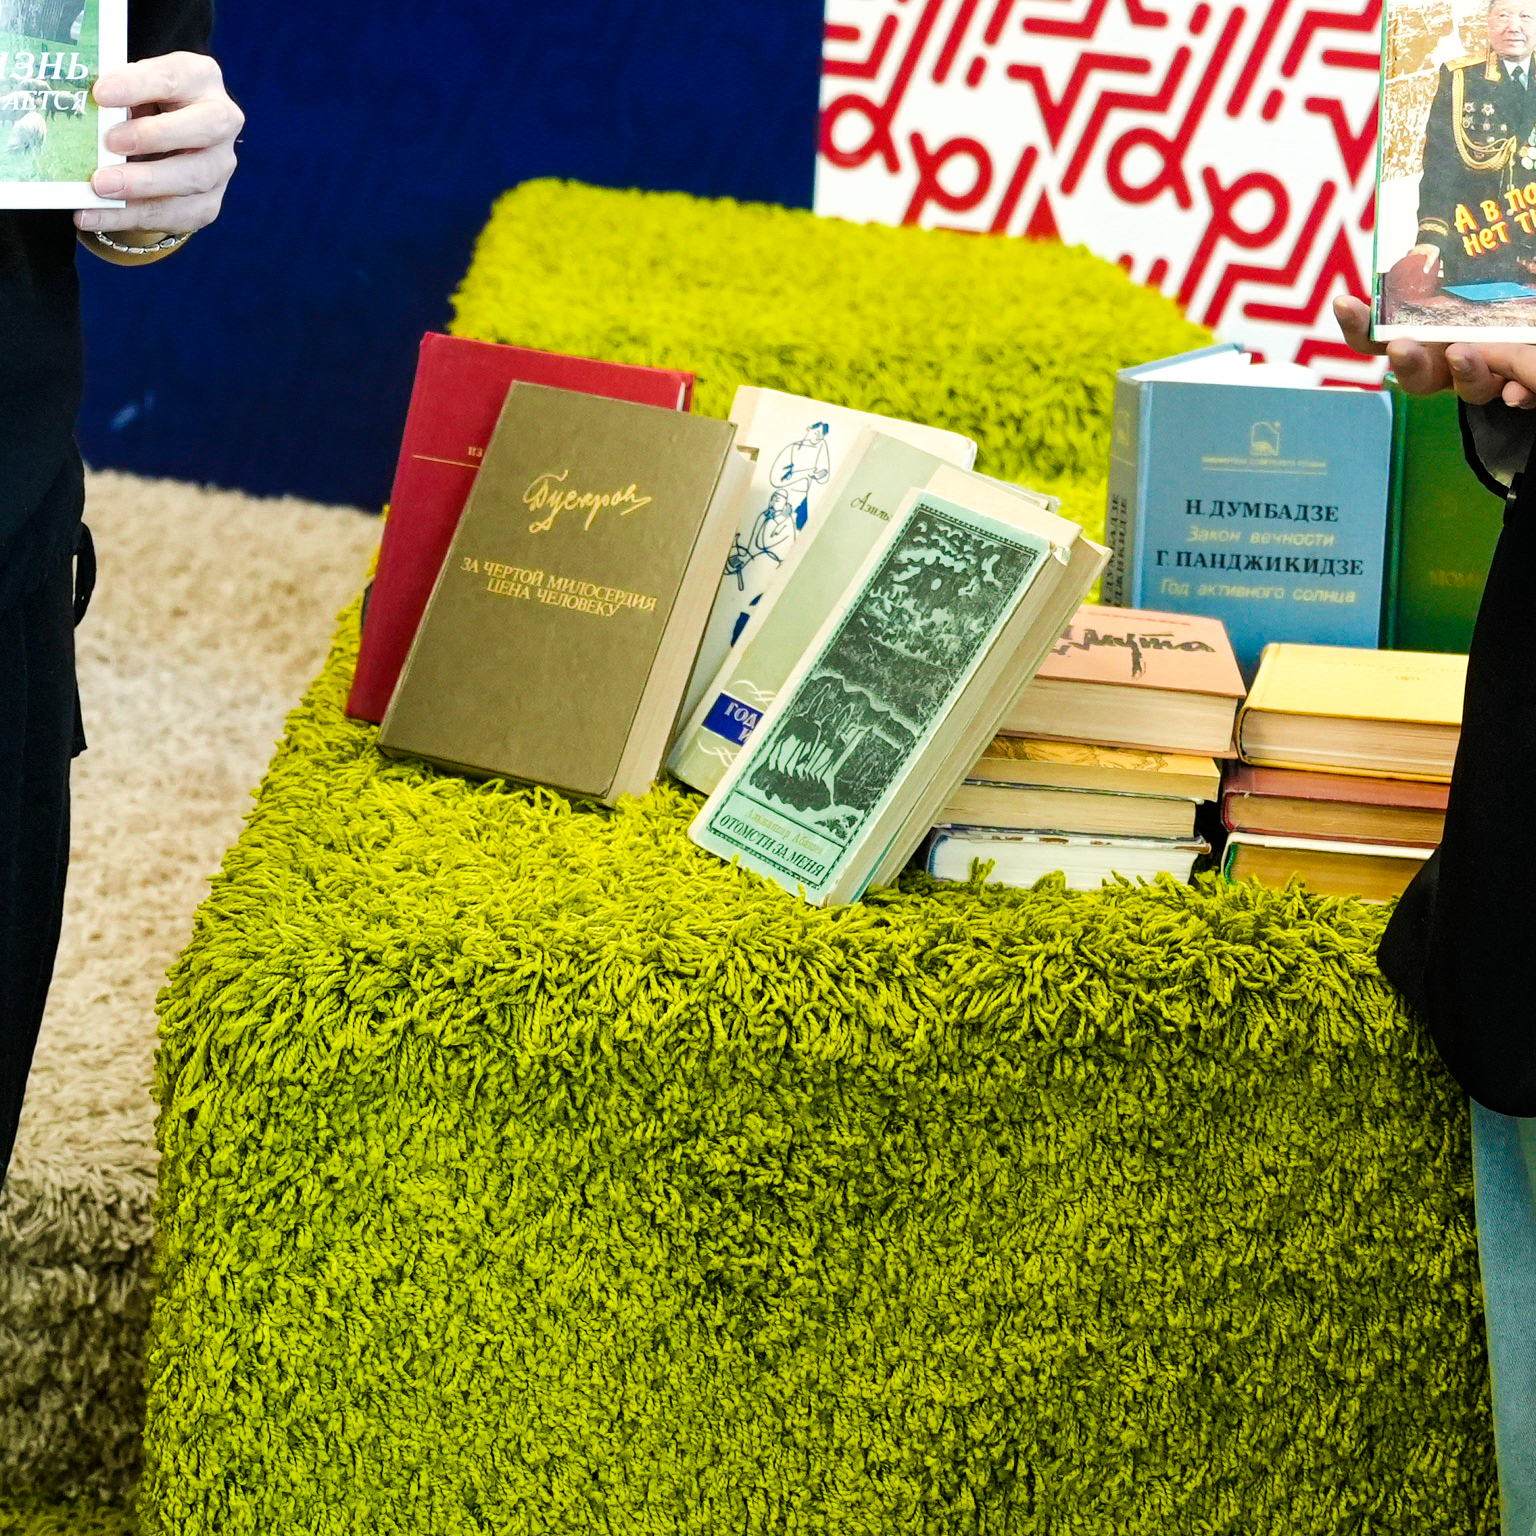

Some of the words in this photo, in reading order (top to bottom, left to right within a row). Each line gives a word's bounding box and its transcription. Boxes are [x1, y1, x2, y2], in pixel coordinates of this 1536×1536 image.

[1453, 203, 1479, 235] А
[1462, 221, 1511, 257] нет
[1185, 498, 1207, 515] Н.
[1209, 500, 1340, 524] ДУМБАДЗЕ
[1186, 525, 1241, 544] Закон
[1249, 529, 1335, 547] вечности
[1175, 550, 1364, 577] ПАНДЖИКИДЗЕ
[460, 556, 480, 574] ЗА
[483, 560, 544, 586] ЧЕРТОЙ
[547, 574, 658, 612] МИЛОСЕРДИЯ
[486, 578, 531, 600] ЦЕНА
[536, 588, 622, 617] ЧЕЛОВЕКУ
[1160, 578, 1189, 599] Год
[1197, 582, 1285, 601] активного
[1292, 586, 1357, 604] солнца
[719, 814, 776, 850] ОТОМСТИ
[771, 843, 789, 862] ЗА
[787, 851, 826, 877] МЕНЯ
